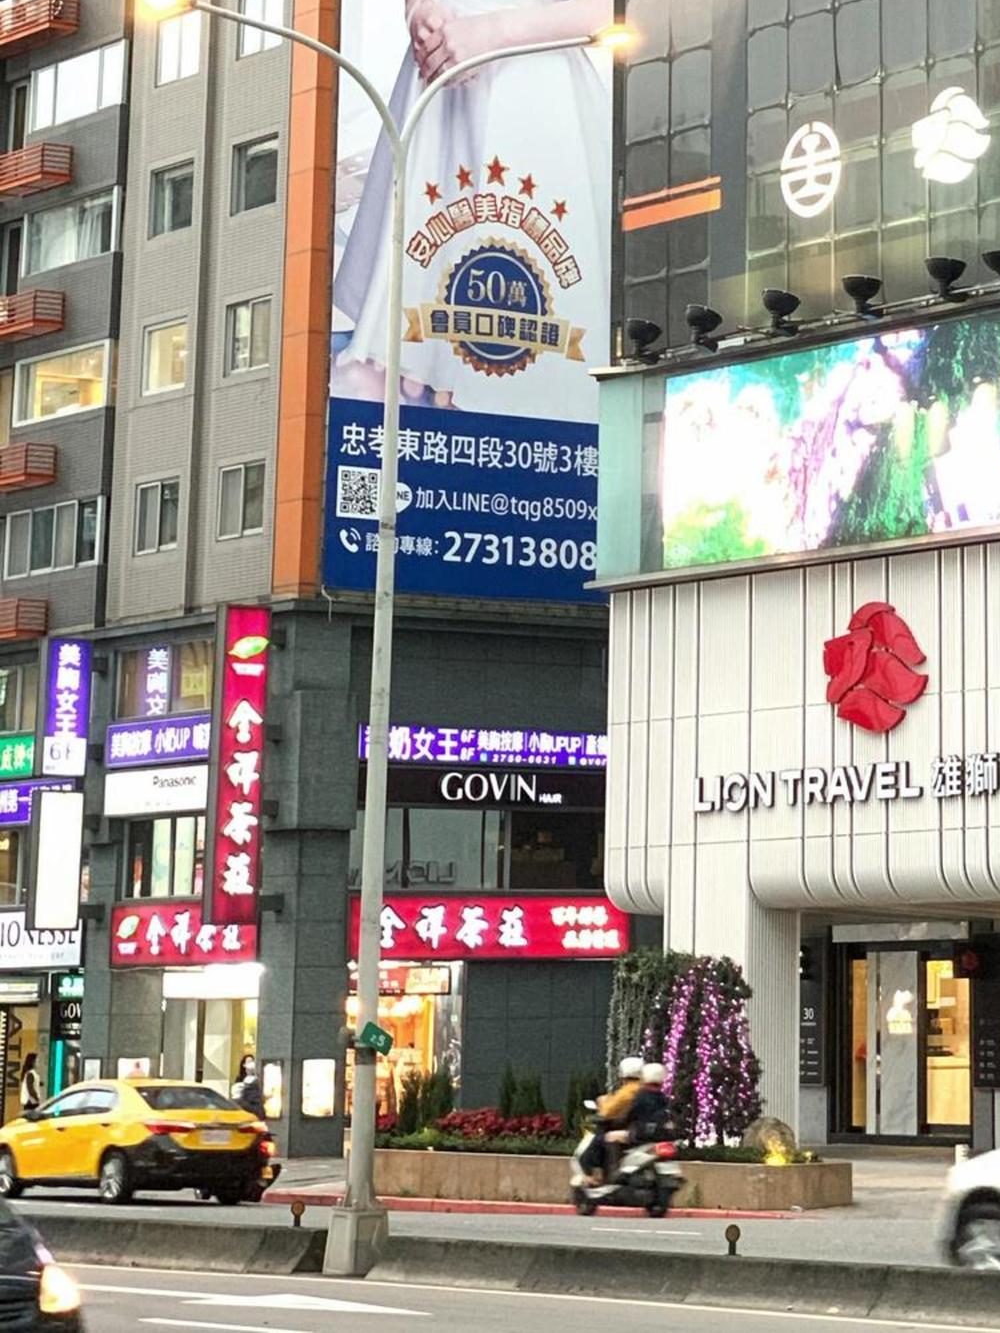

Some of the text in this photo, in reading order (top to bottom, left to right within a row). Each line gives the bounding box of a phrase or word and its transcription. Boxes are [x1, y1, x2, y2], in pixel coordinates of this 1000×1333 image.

[406, 193, 582, 289] 安心醫美指標品牌
[467, 269, 527, 307] 50萬
[431, 309, 559, 347] 會員口碑認證
[365, 530, 596, 571] 諮專線: 27313808
[441, 772, 537, 803] GOVIN
[694, 771, 775, 815] LION
[780, 760, 924, 806] TRAVEL
[803, 1007, 814, 1020] 30
